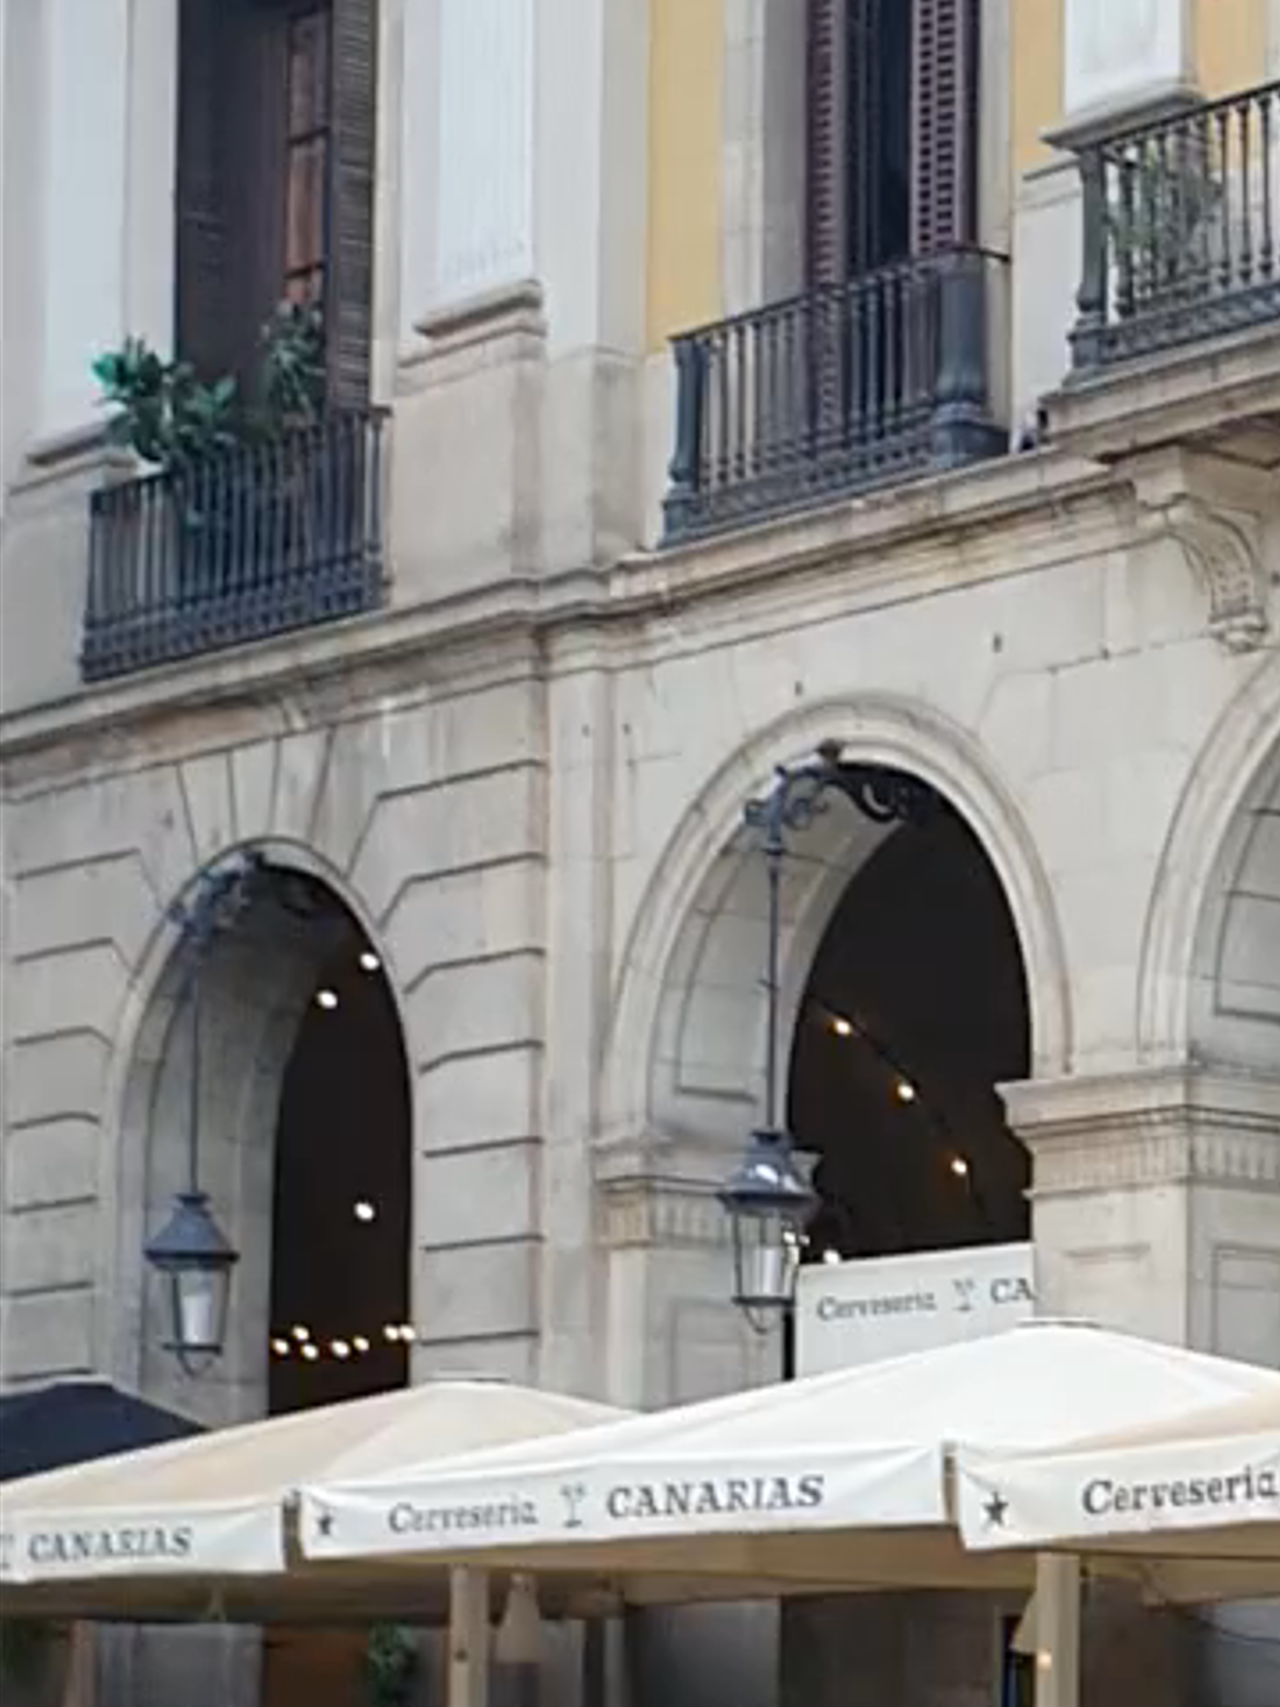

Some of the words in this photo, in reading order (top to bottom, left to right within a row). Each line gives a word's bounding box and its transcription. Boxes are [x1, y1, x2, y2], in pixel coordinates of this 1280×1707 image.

[388, 1493, 539, 1533] Cerveseria
[606, 1474, 825, 1519] CANARIAS
[1082, 1462, 1279, 1516] Cerveseria
[27, 1526, 193, 1562] CANARIAS
